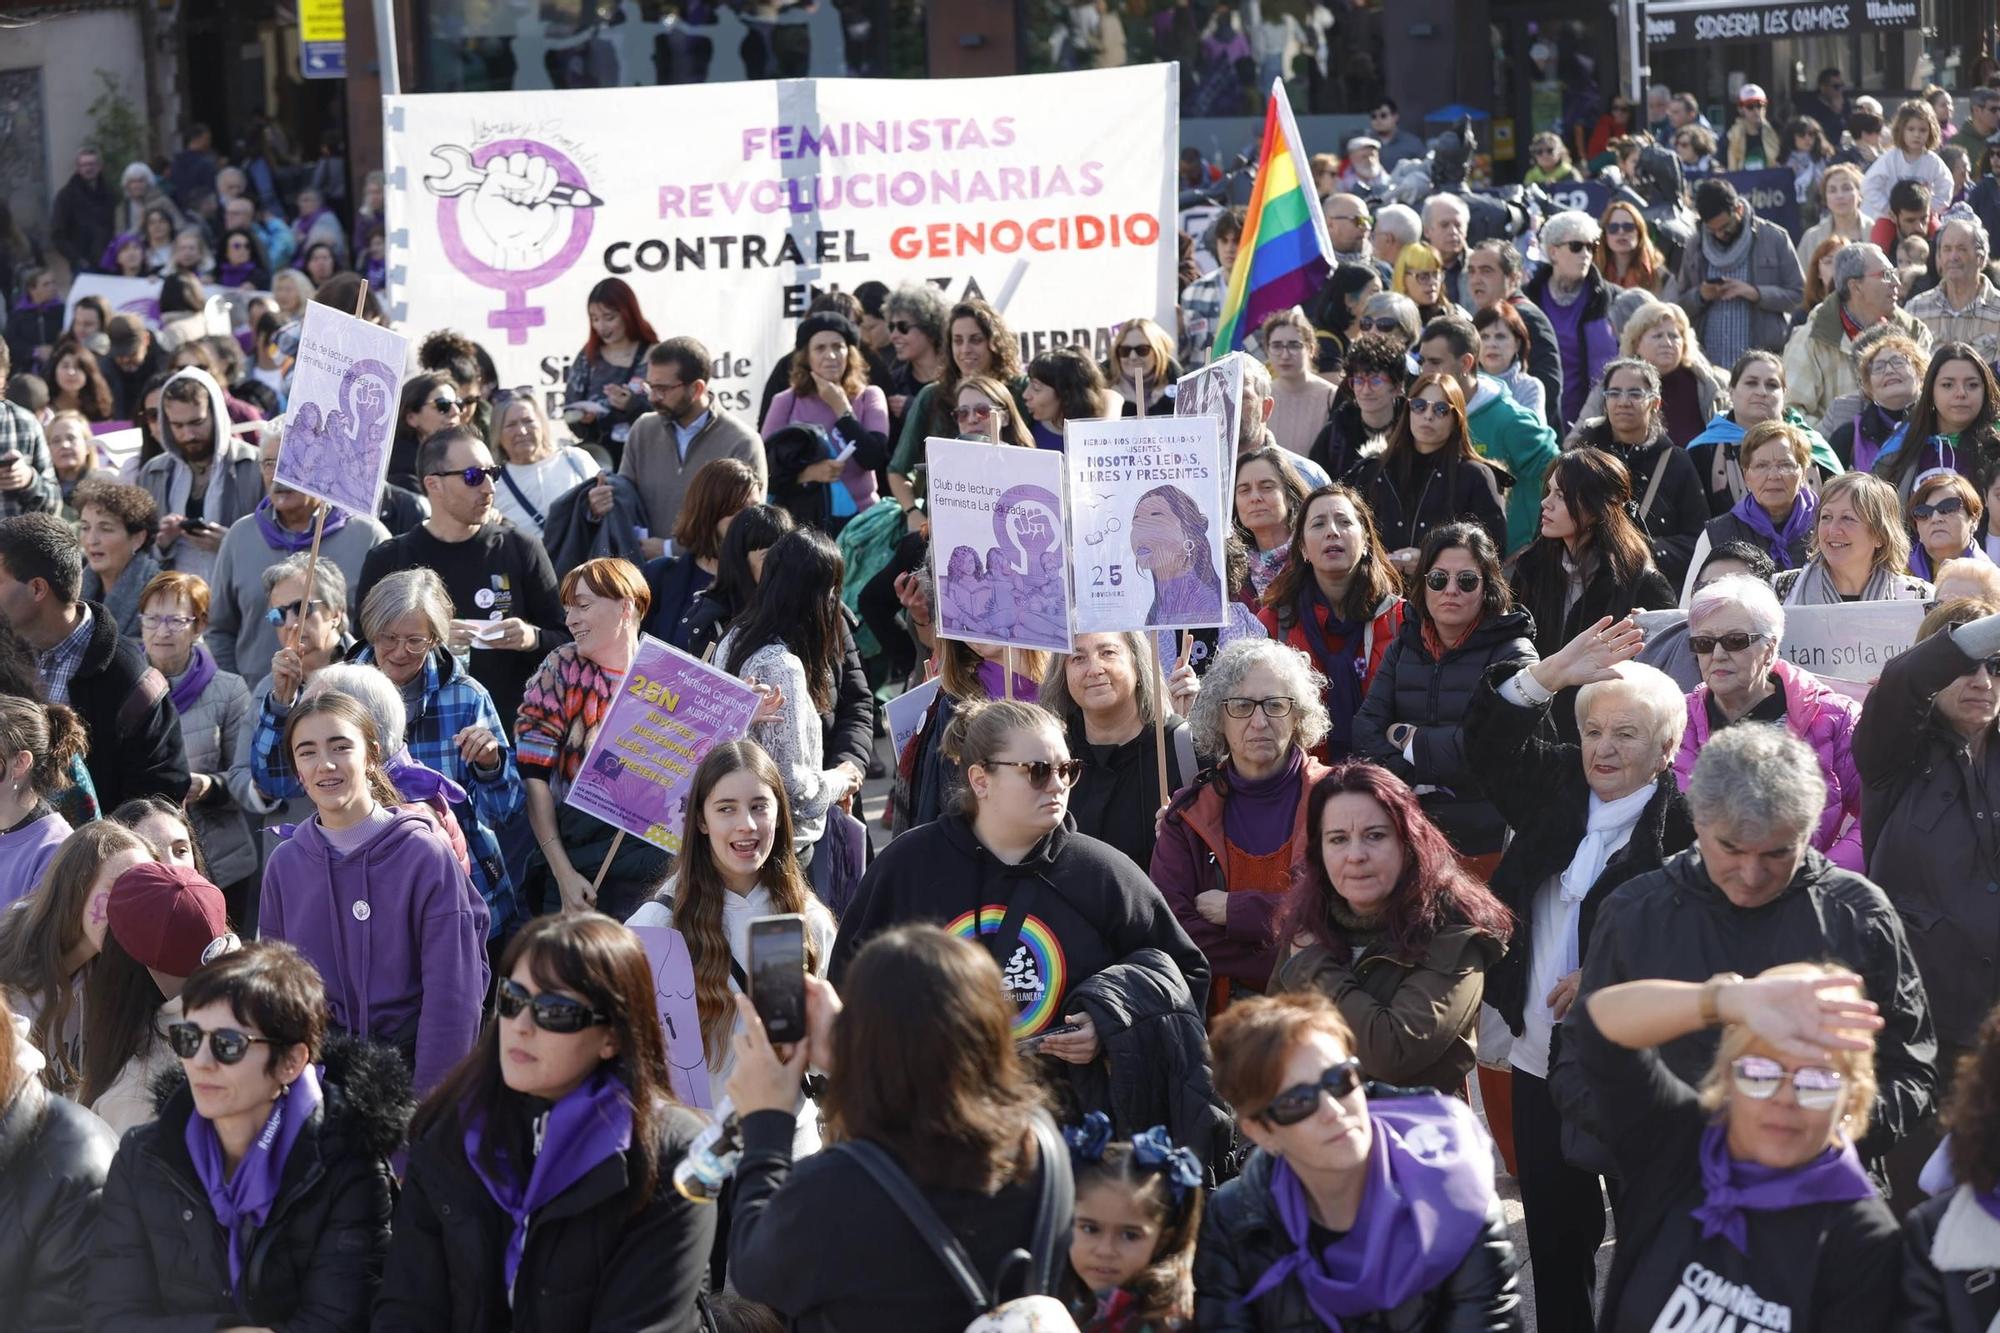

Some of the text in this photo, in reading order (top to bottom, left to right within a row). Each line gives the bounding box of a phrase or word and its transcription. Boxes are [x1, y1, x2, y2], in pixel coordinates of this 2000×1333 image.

[1694, 4, 1850, 40] SIDRERIA LES CAMPES
[1866, 0, 1916, 19] Mahou
[742, 117, 1016, 161] FEMINISTAS
[658, 161, 1104, 220] REVOLUCIONARIAS
[602, 212, 1161, 275] CONTRA EL GENOCIDIO
[1087, 453, 1201, 468] NOSOTRAS LEÍDAS,
[934, 478, 1001, 497] Club de lectura
[1080, 467, 1209, 483] LIBRES Y PRESENTES
[979, 499, 990, 511] La
[991, 501, 1026, 516] Calzada
[1790, 644, 1826, 666] tan
[1832, 640, 1878, 666] sola
[628, 675, 680, 713] 25N
